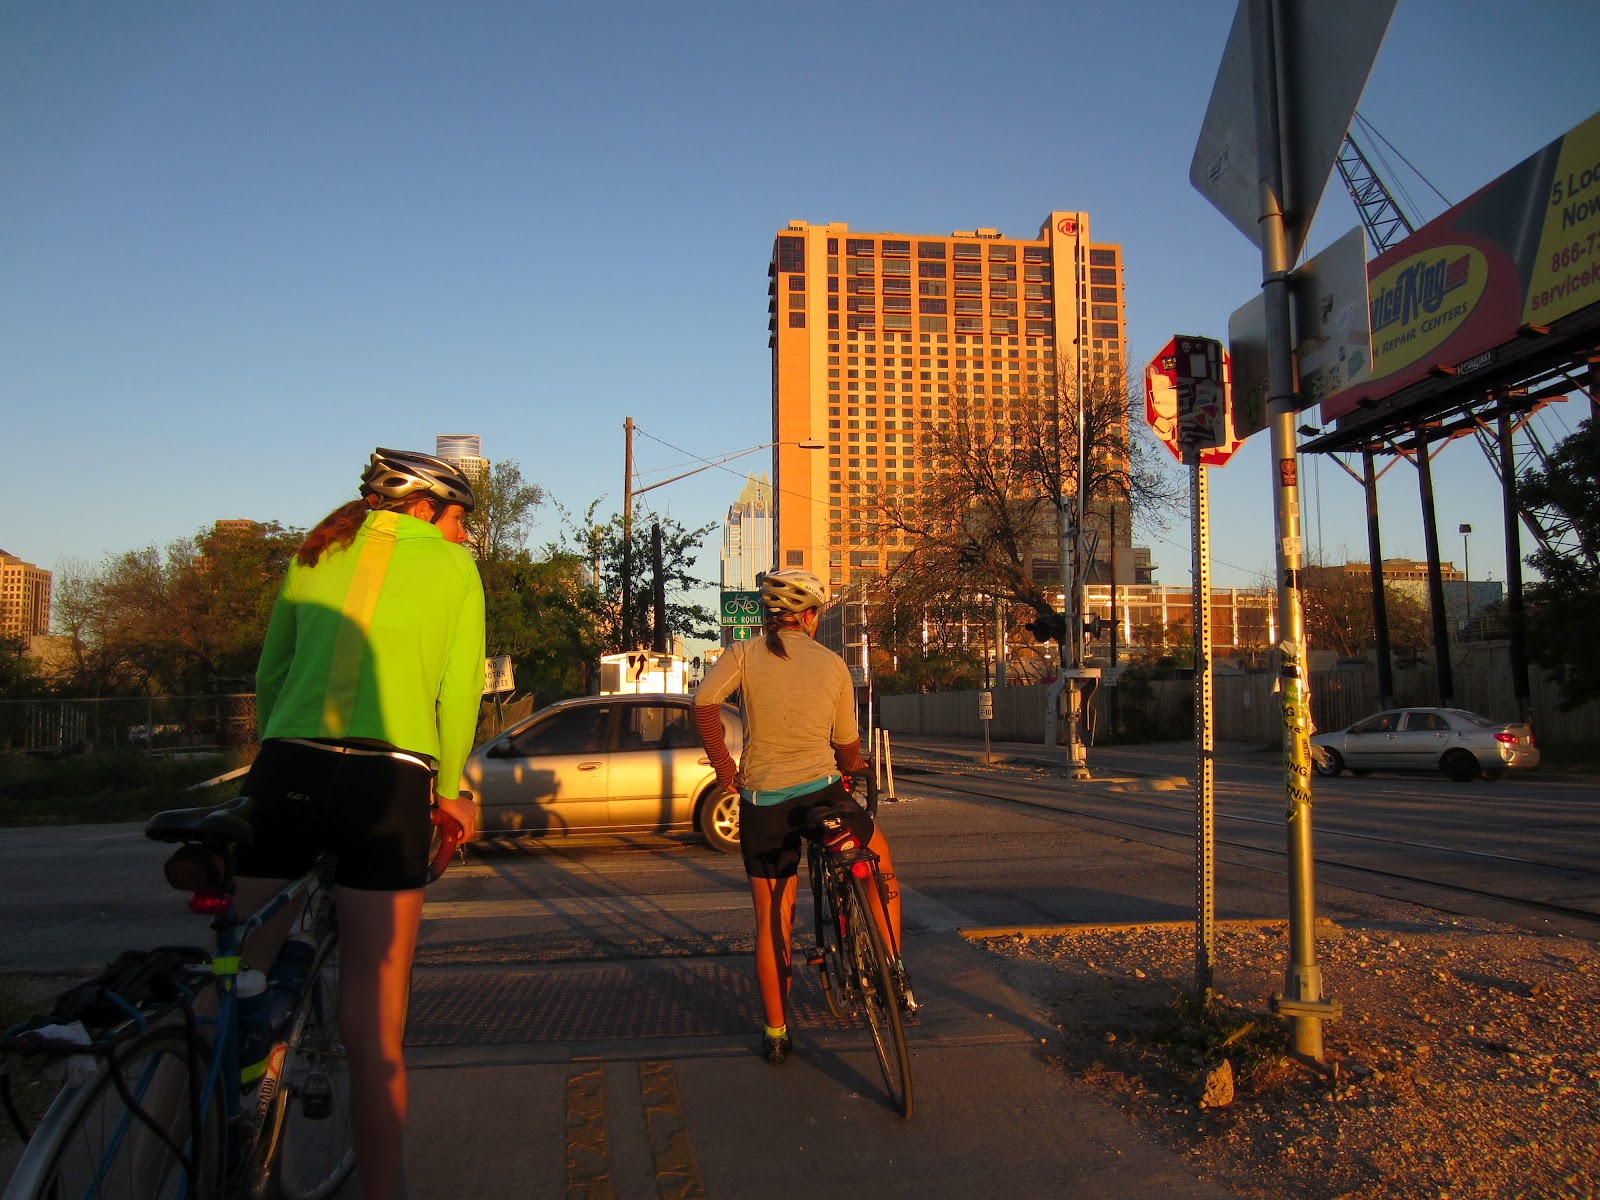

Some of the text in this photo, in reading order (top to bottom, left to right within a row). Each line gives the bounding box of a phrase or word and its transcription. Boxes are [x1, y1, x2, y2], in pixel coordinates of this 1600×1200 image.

[1552, 180, 1563, 206] 5
[1382, 328, 1416, 353] REPAIR
[1420, 301, 1468, 334] CENTERS
[1456, 351, 1491, 377] Reagan
[722, 615, 762, 624] BIKE ROUTE
[487, 660, 497, 669] NO
[484, 679, 509, 689] EHICLES
